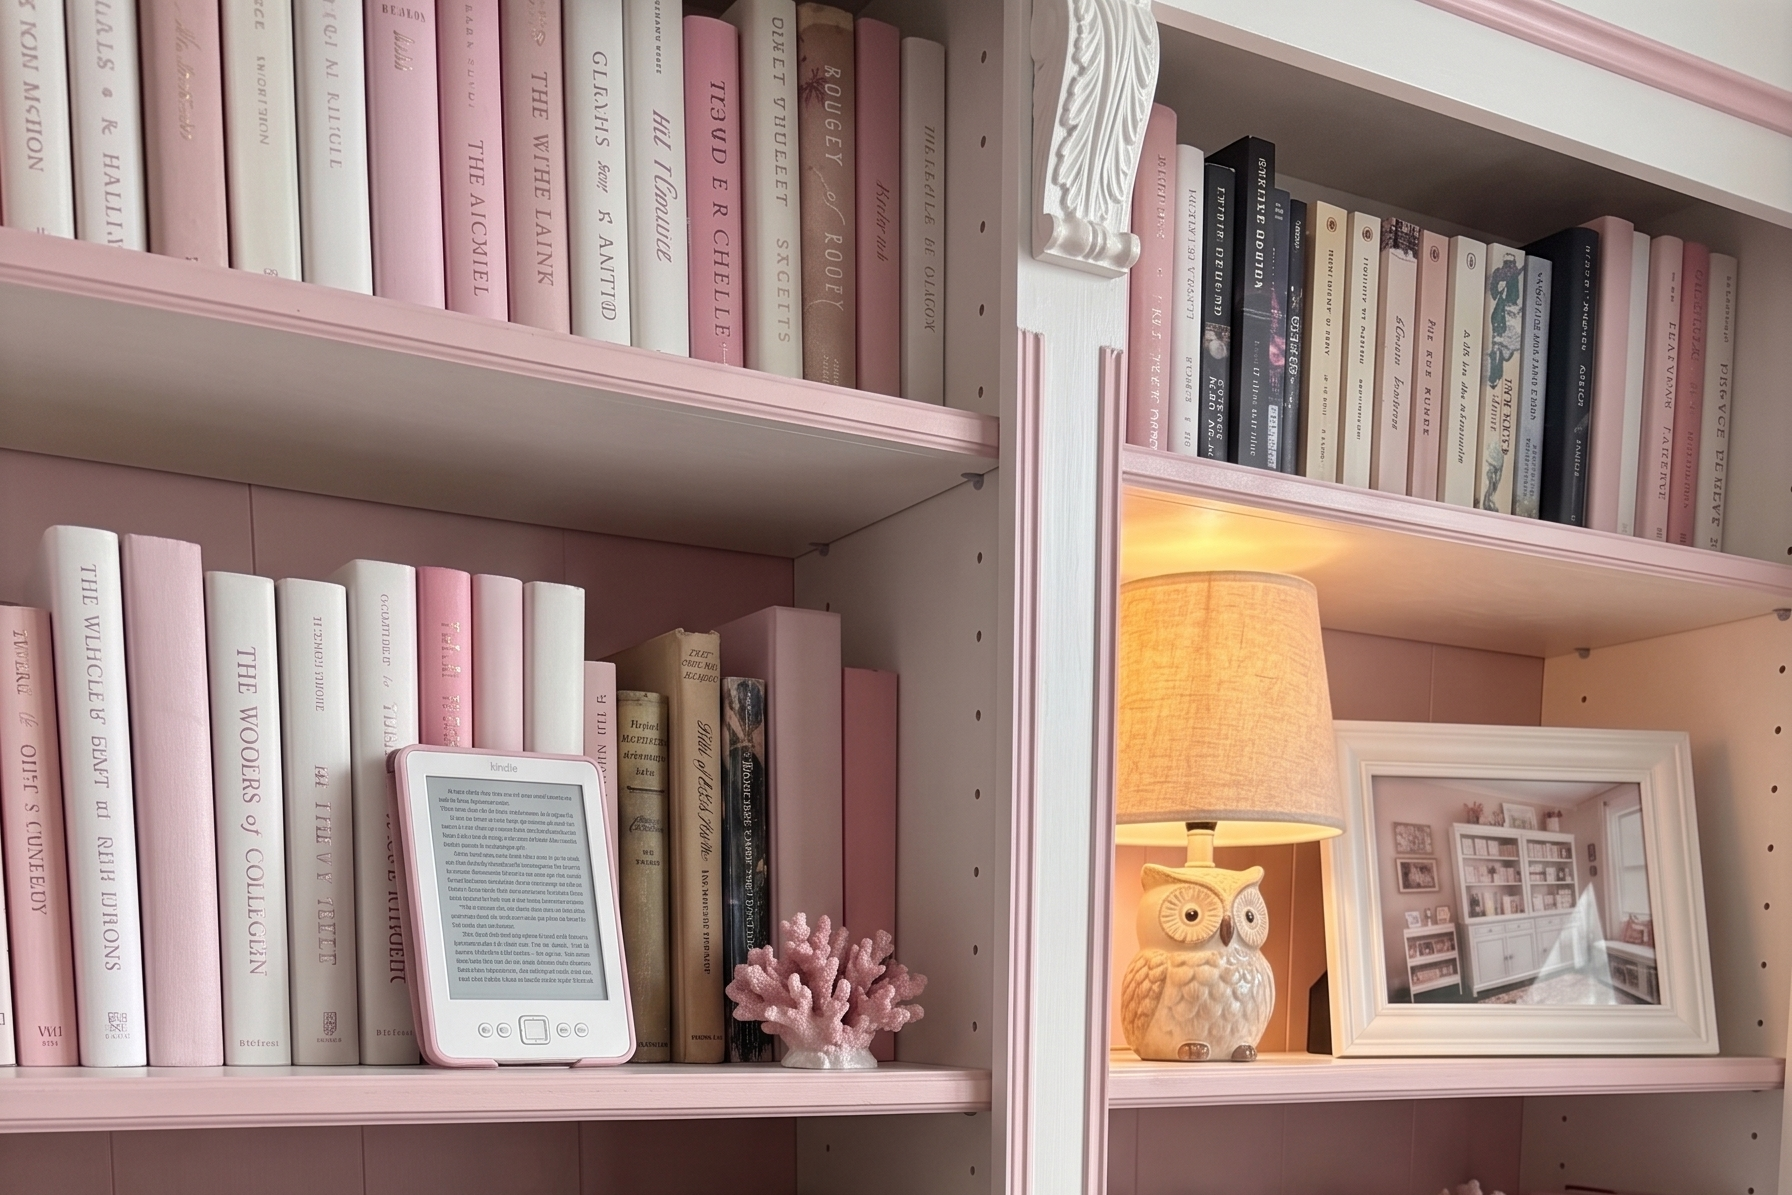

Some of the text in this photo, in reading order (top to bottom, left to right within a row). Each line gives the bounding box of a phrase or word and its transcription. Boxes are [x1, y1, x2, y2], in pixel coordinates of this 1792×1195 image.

[531, 71, 549, 120] THE
[468, 140, 485, 185] THE
[713, 229, 731, 338] CHELLE
[81, 564, 98, 606] THE
[237, 647, 258, 694] THE
[241, 815, 262, 838] of
